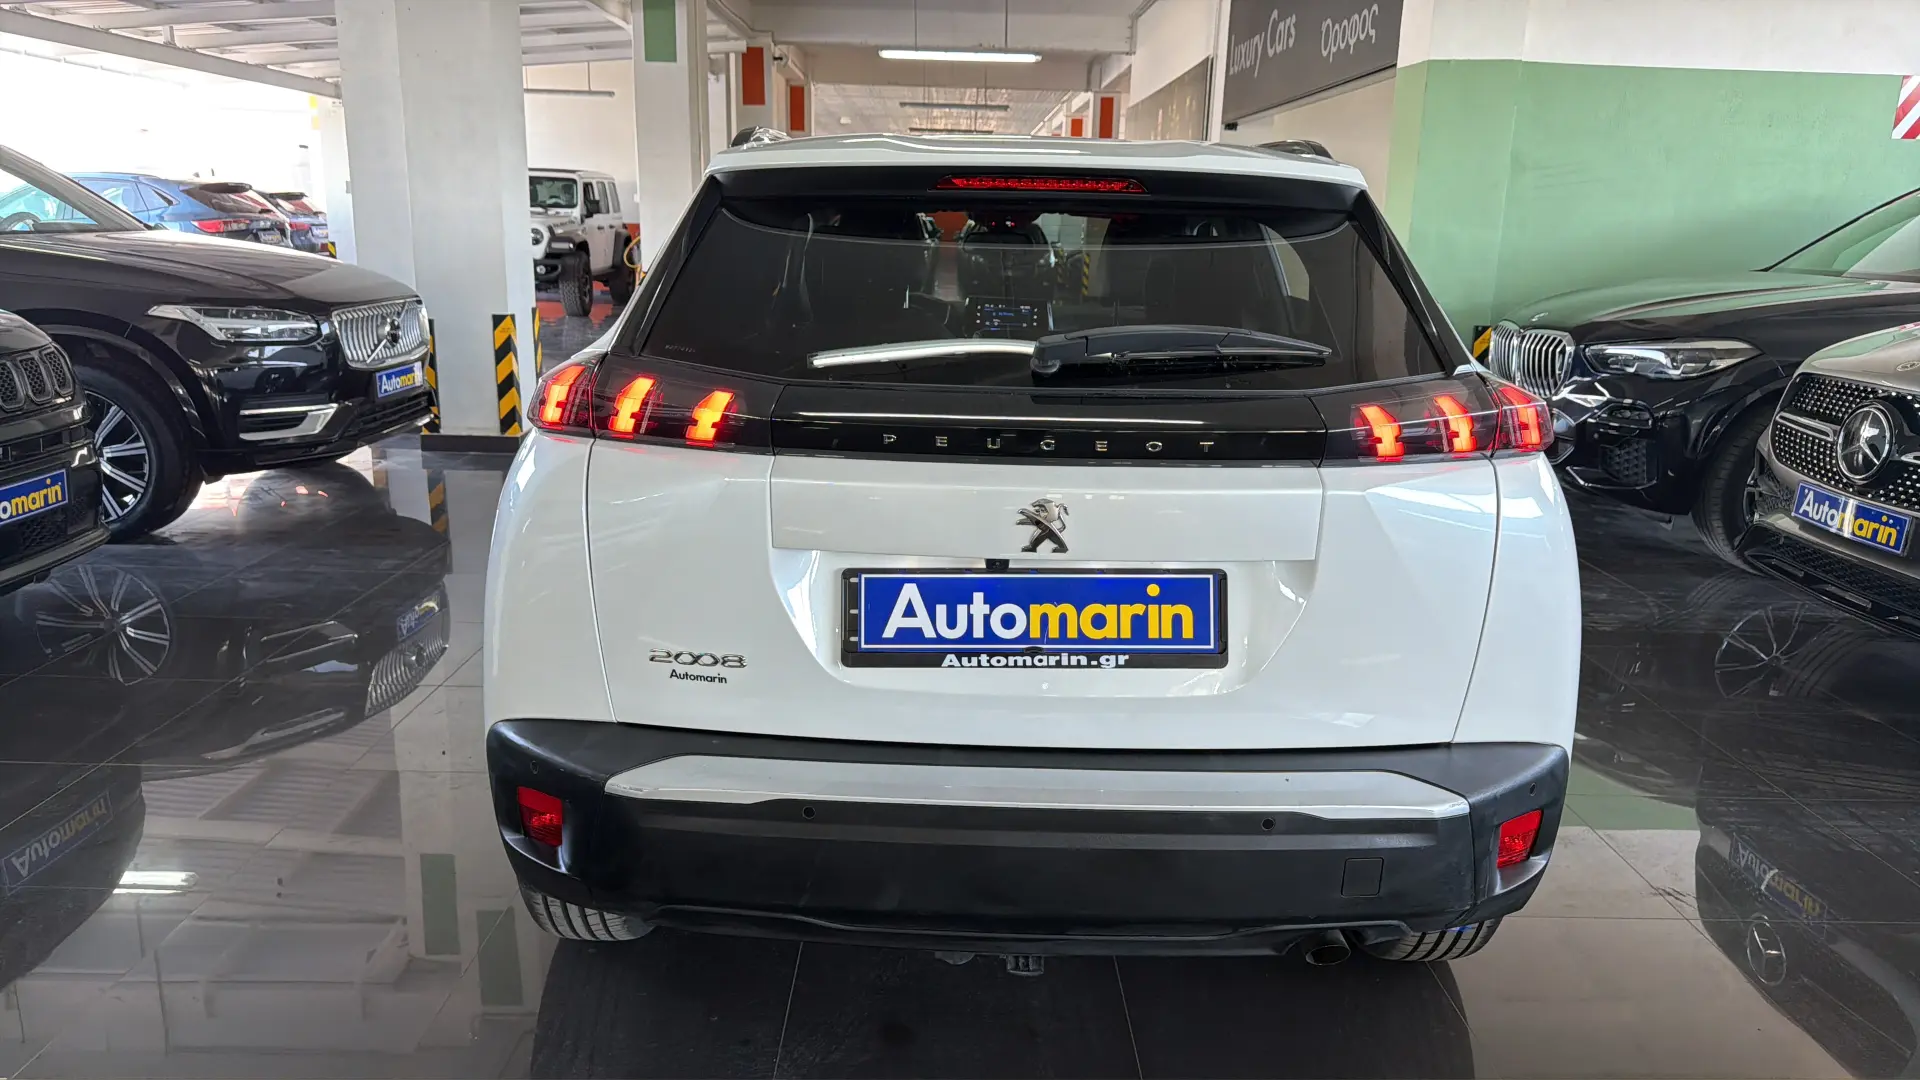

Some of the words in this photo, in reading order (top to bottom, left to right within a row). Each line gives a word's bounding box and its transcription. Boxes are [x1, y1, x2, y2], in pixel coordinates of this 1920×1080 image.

[1229, 32, 1265, 78] Luxury
[1267, 9, 1296, 58] Cars
[883, 433, 1215, 453] PEUGEOT
[0, 478, 62, 520] omarin
[1799, 490, 1898, 547] Automarin
[882, 583, 1194, 639] Automarin
[649, 648, 748, 668] 2008
[941, 653, 1129, 668] Automarin.gr
[669, 669, 728, 684] Automarin
